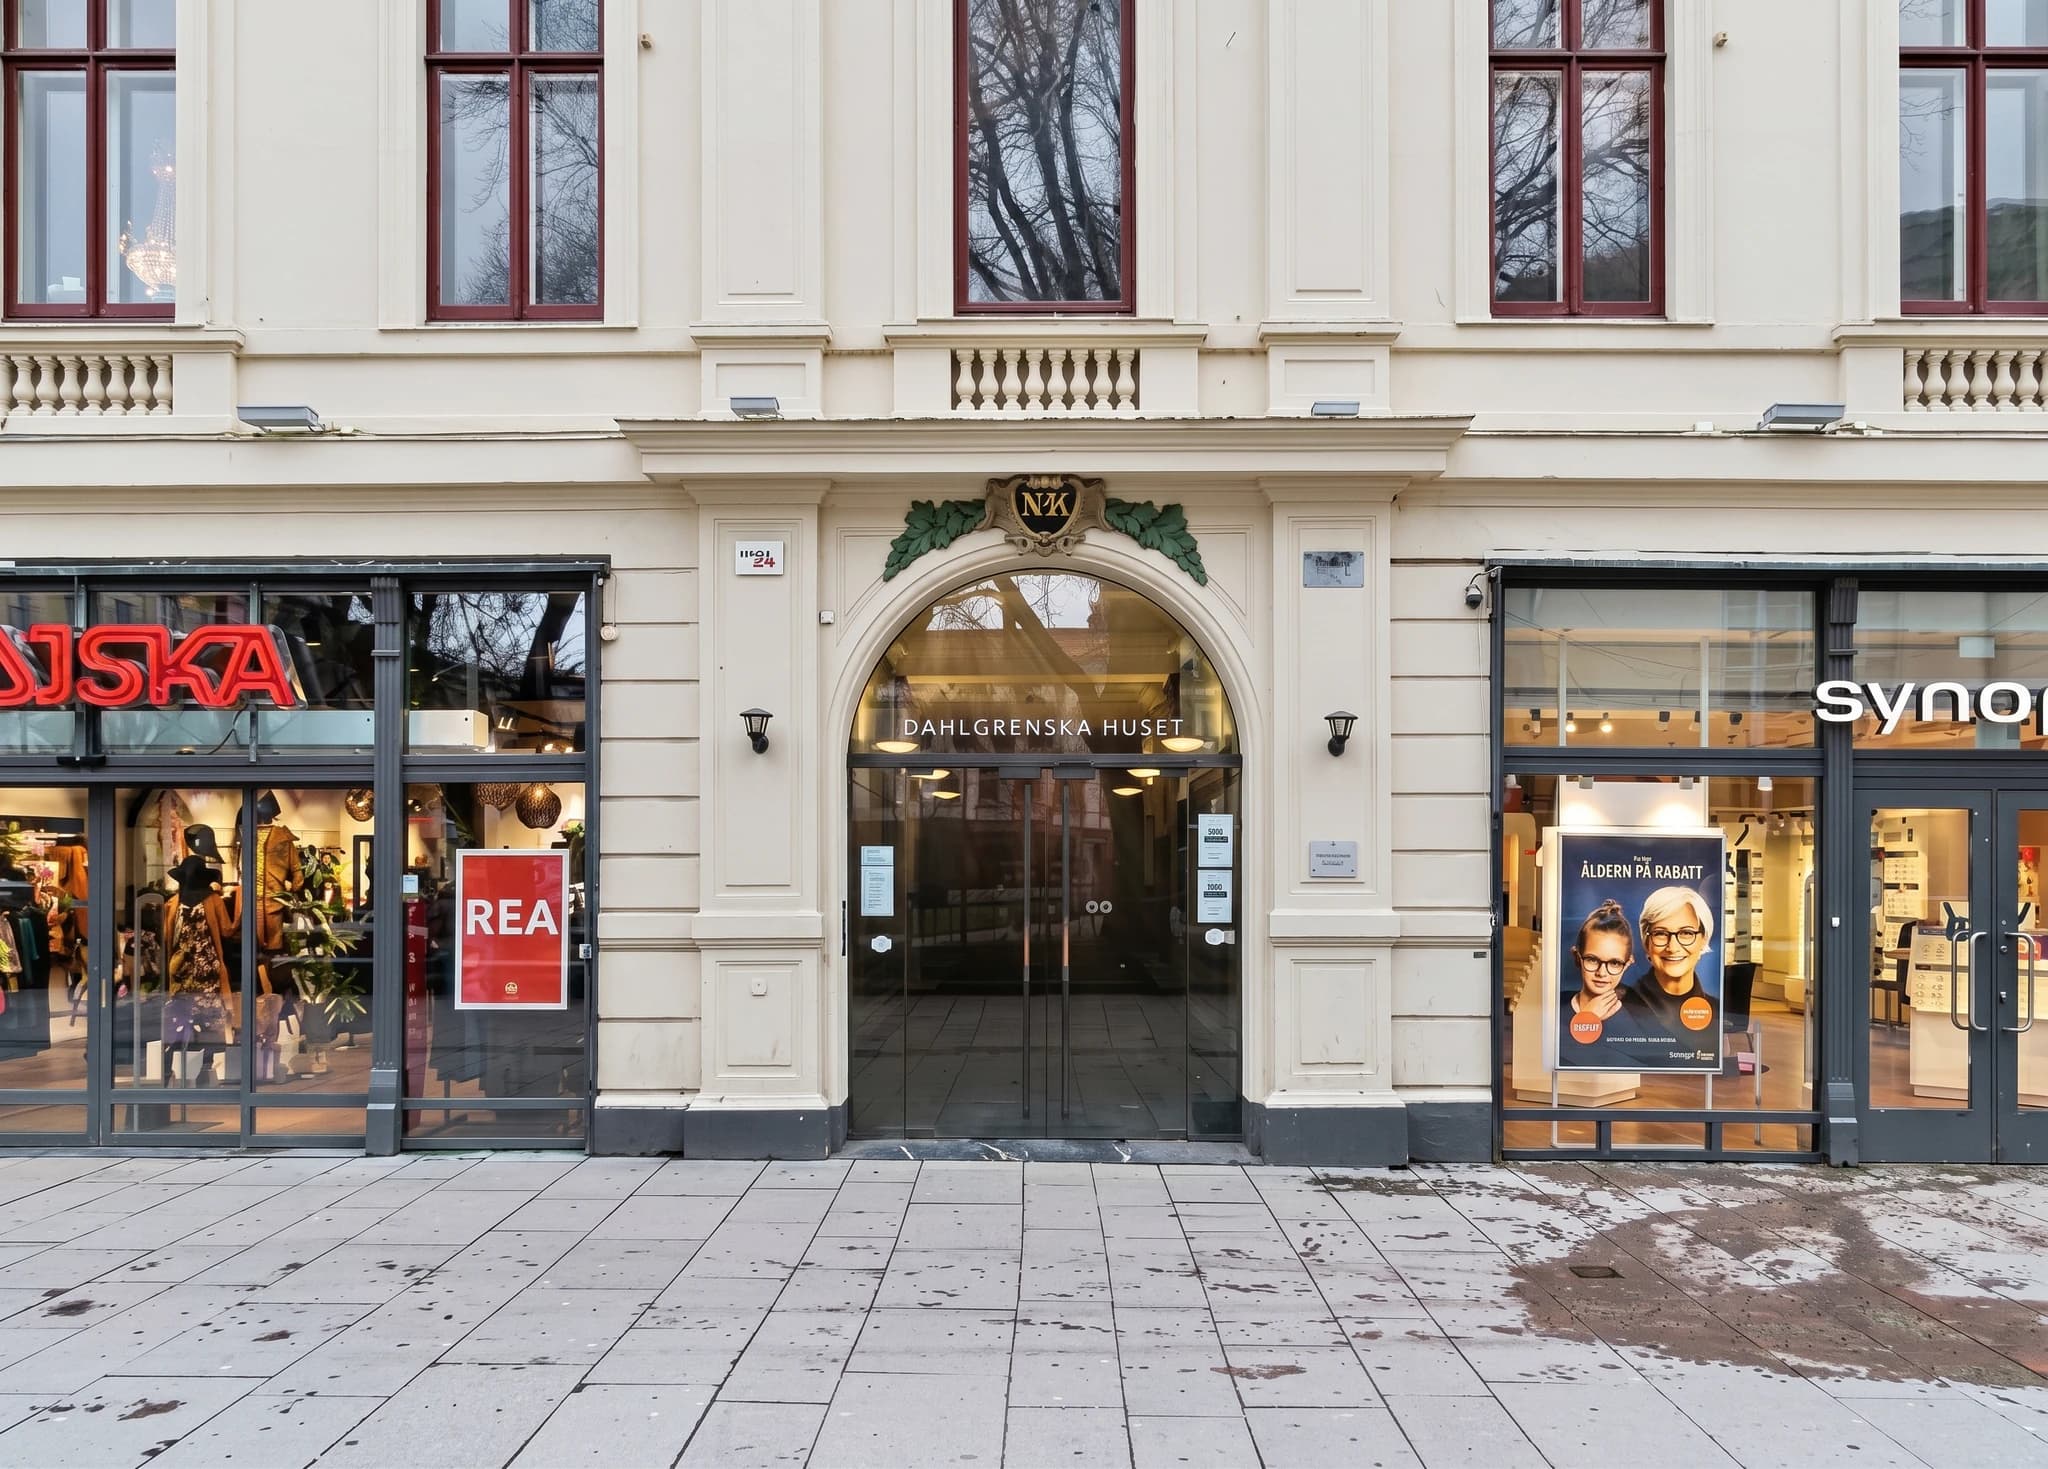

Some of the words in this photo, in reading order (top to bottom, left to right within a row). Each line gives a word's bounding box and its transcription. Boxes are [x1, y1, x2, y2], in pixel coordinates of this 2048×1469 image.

[753, 557, 776, 568] 24
[1815, 680, 2048, 736] syno
[904, 718, 1092, 737] DAHLGRENSKA
[1102, 718, 1184, 737] HUSET
[1581, 860, 1631, 879] ÅLDERN
[1635, 861, 1652, 879] PÅ
[1655, 865, 1703, 880] RABATT
[466, 899, 559, 935] REA
